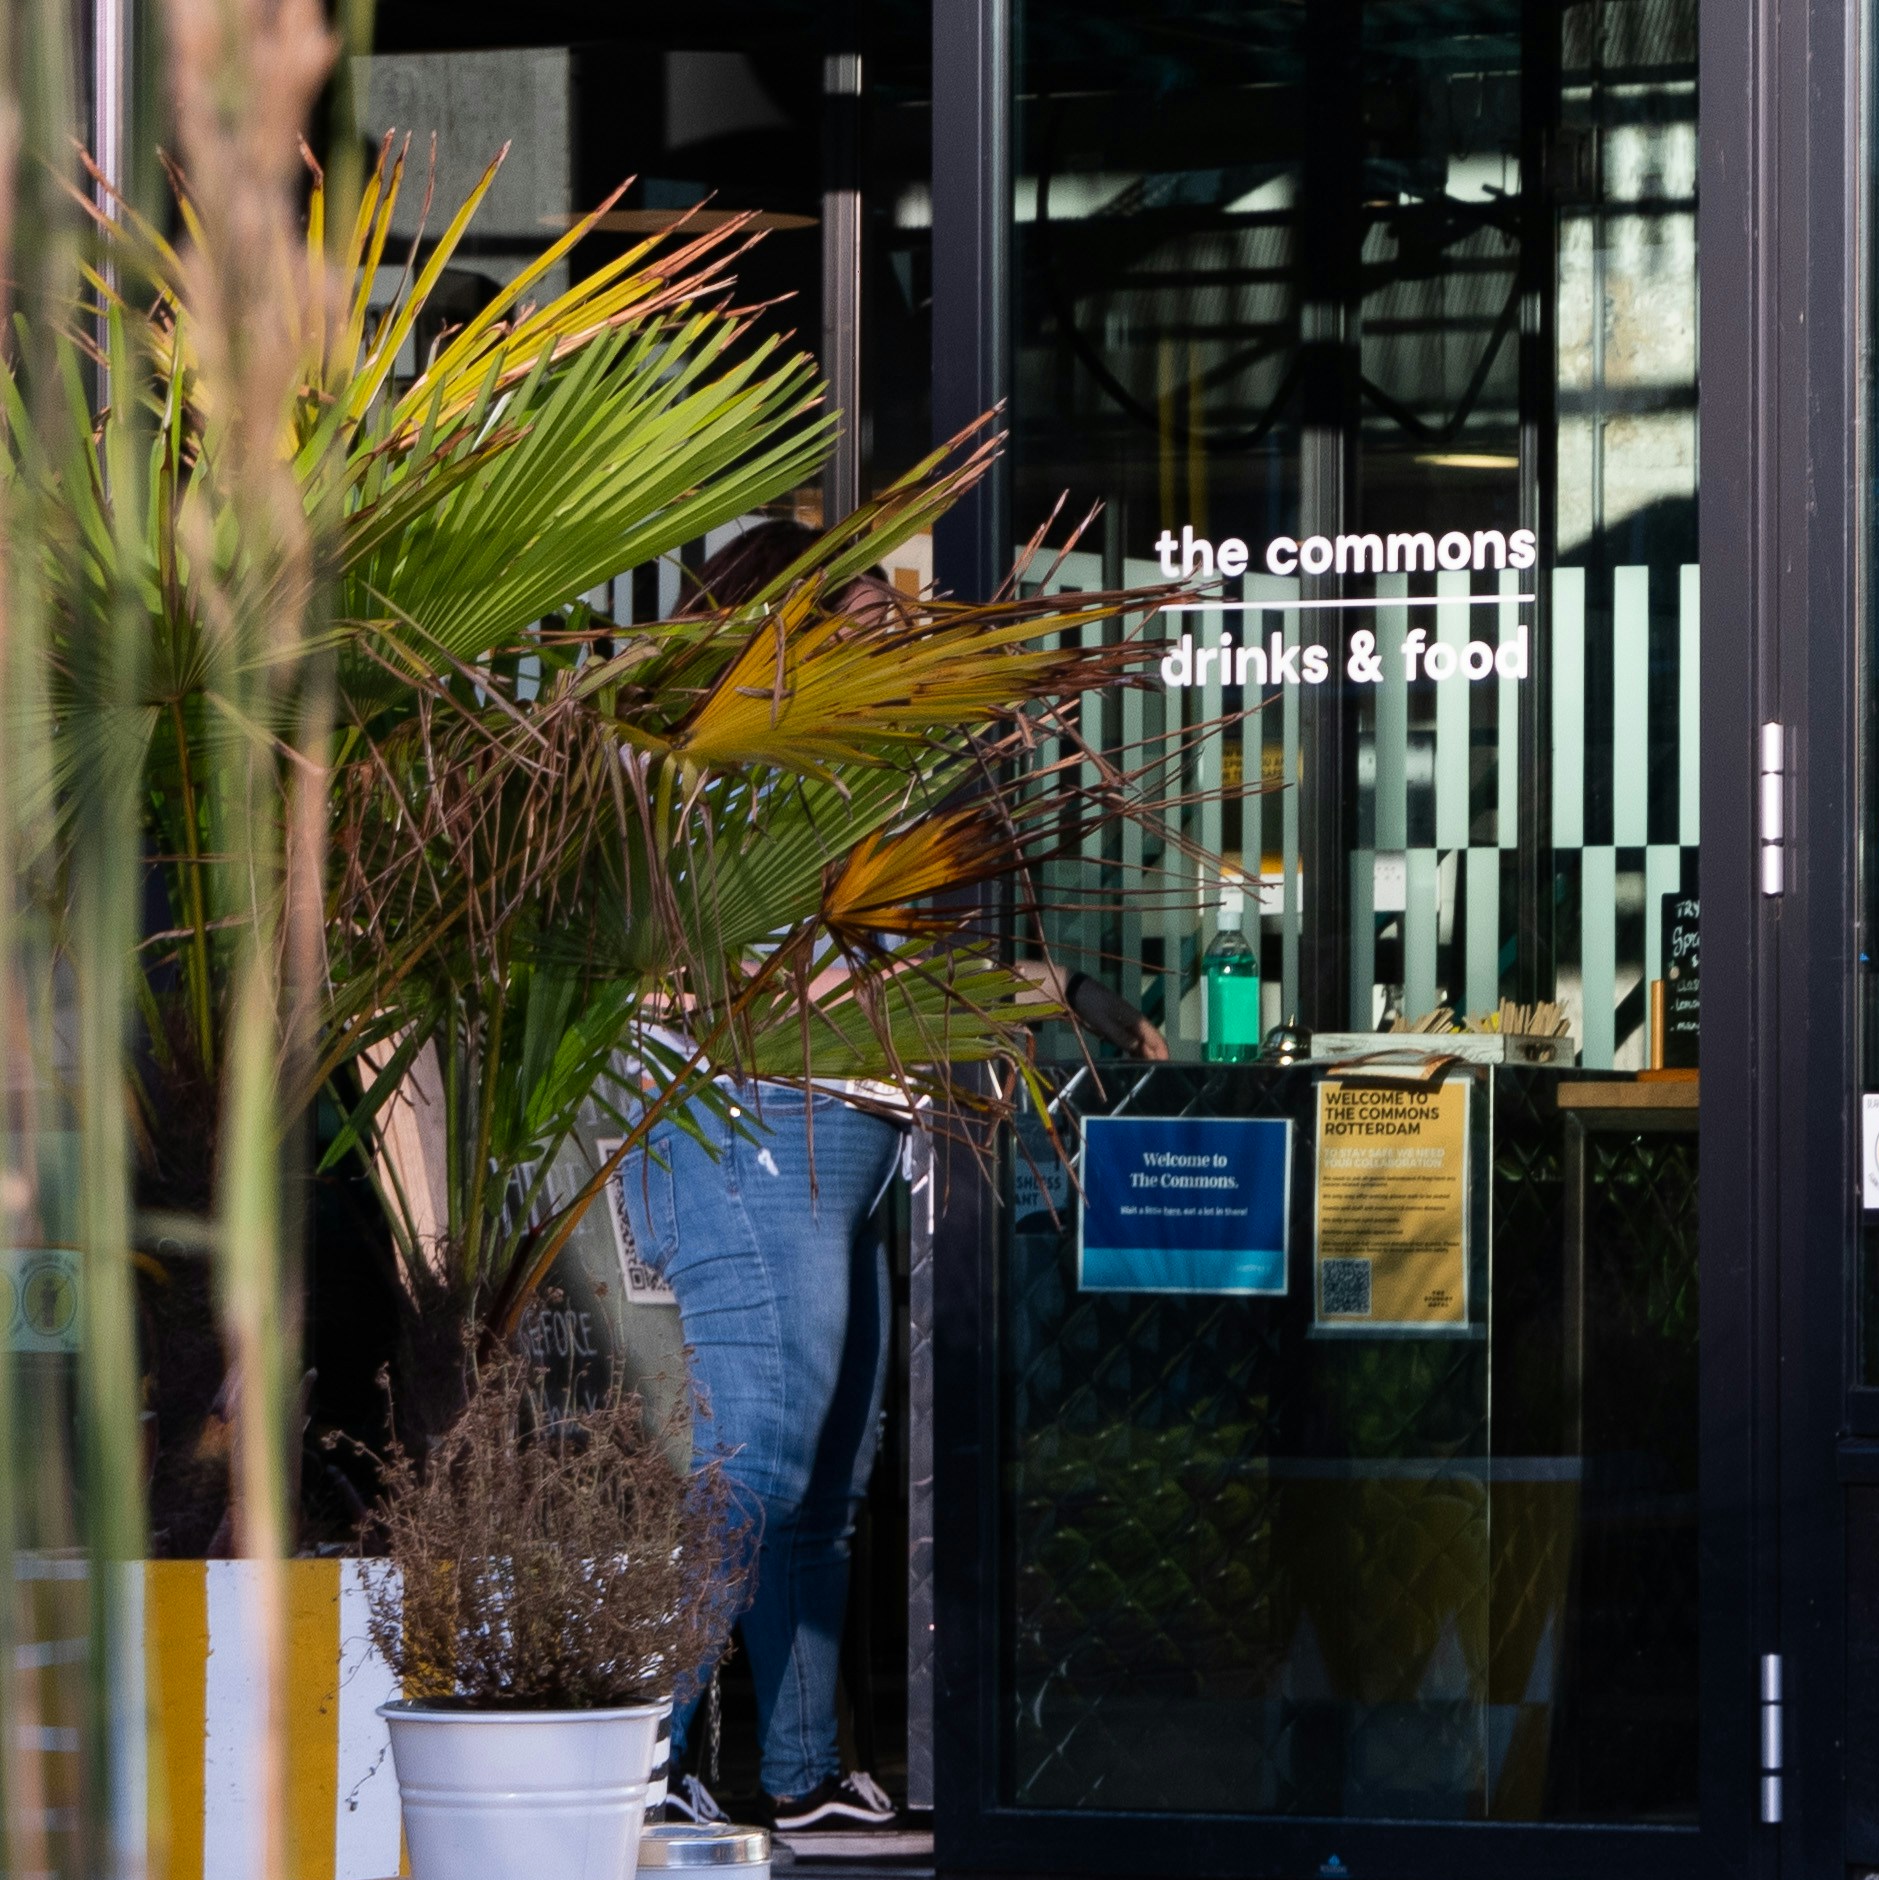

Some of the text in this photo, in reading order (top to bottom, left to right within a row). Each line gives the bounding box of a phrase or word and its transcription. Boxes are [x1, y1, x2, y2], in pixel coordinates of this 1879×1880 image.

[1155, 525, 1537, 579] the commons
[1161, 625, 1530, 688] drinks & food
[1325, 1092, 1429, 1106] WELCOME TO
[1325, 1107, 1440, 1121] THE COMMONS
[1324, 1122, 1421, 1136] ROTTERDAM
[1142, 1151, 1228, 1169] Welcome to
[1339, 1147, 1368, 1158] STAY
[1129, 1172, 1240, 1190] The Commons.
